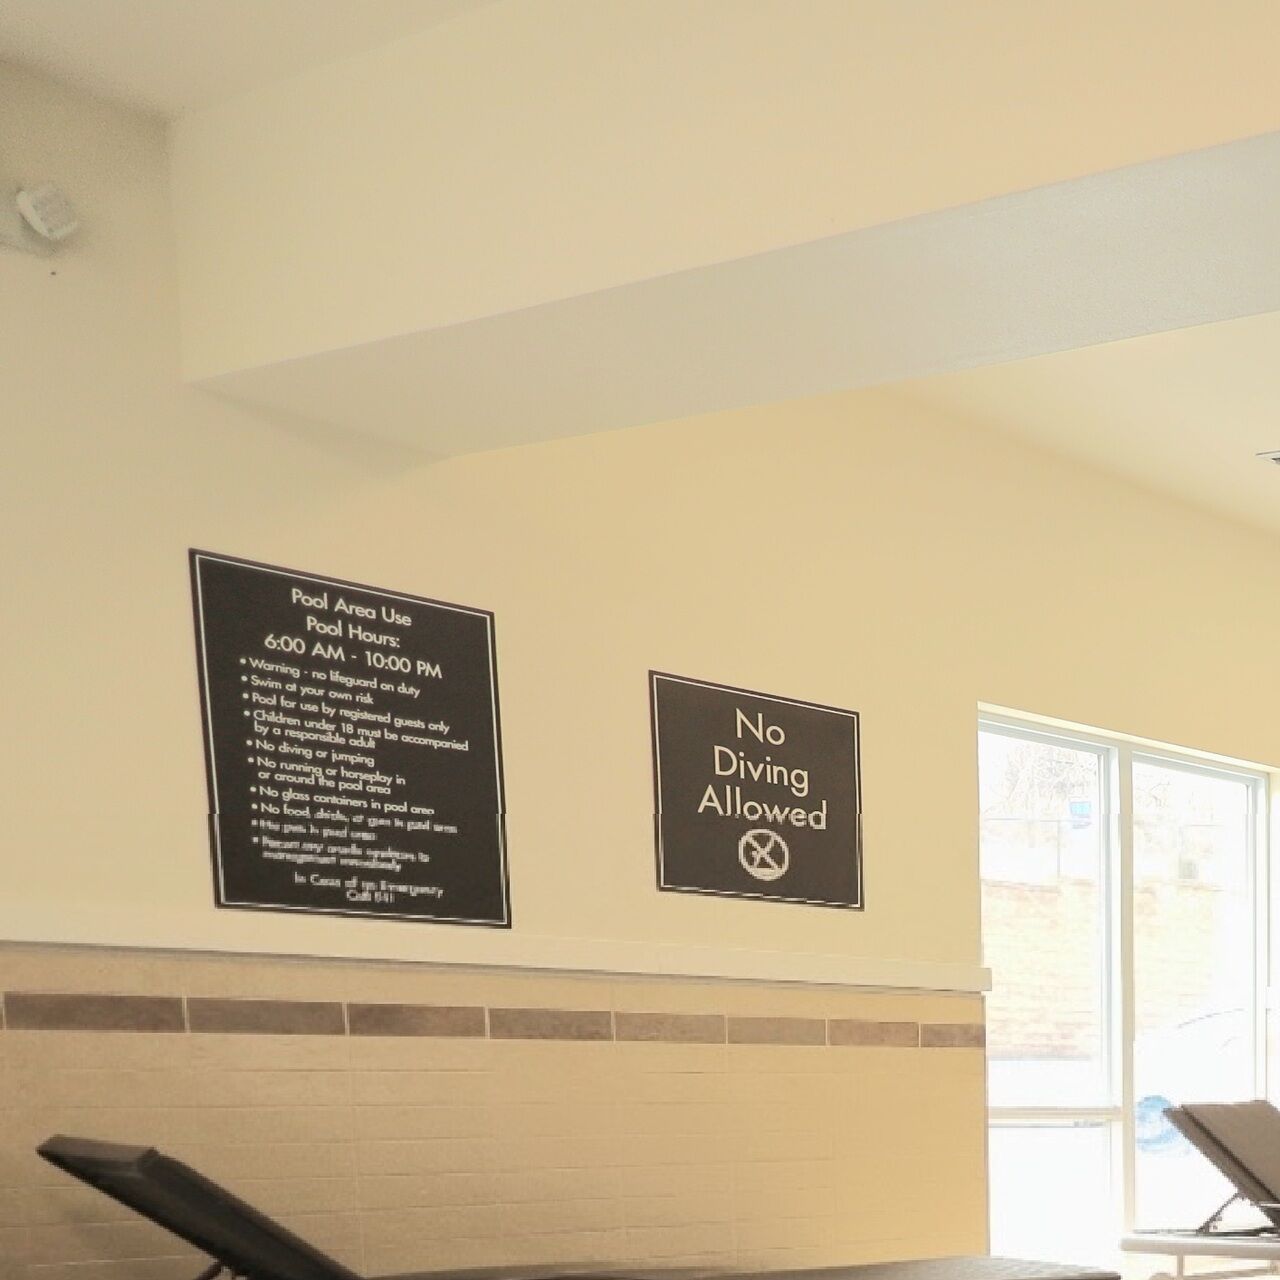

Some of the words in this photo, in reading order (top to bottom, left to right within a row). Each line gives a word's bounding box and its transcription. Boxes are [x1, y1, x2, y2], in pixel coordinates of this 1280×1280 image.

[292, 588, 328, 609] Pool
[334, 598, 376, 619] Area
[382, 606, 412, 626] Use
[306, 616, 342, 637] Pool
[348, 624, 400, 647] Hours:
[264, 634, 306, 654] 6:00
[311, 642, 345, 661] AM
[365, 651, 411, 673] 10:00
[416, 660, 442, 679] PM
[249, 657, 300, 678] Warning
[312, 671, 327, 680] no
[329, 670, 377, 689] lifeguard
[380, 683, 394, 692] on
[397, 682, 420, 698] duty
[251, 675, 282, 689] Swim
[285, 683, 297, 691] at
[300, 686, 325, 696] your
[328, 691, 352, 700] own
[356, 693, 374, 704] risk
[252, 692, 277, 705] Pool
[280, 695, 296, 708] for
[300, 703, 319, 712] use
[321, 702, 336, 717] by
[339, 709, 390, 723] registered
[394, 718, 425, 729] guests
[428, 721, 450, 735] only
[253, 710, 300, 726] Children
[304, 719, 336, 731] under
[341, 722, 354, 734] 18
[357, 728, 381, 738] must
[384, 728, 398, 740] be
[401, 735, 469, 751] accompanied
[736, 708, 785, 745] No
[254, 720, 269, 736] by
[284, 729, 346, 745] responsible
[348, 736, 375, 749] adult
[256, 739, 275, 751] No
[279, 741, 312, 759] diving
[316, 750, 328, 758] or
[331, 749, 375, 767] jumping
[257, 756, 277, 768] No
[280, 762, 322, 776] running
[325, 768, 338, 776] or
[341, 766, 392, 786] horseplay
[396, 774, 406, 785] in
[258, 771, 271, 779] or
[274, 774, 315, 785] around
[319, 775, 335, 787] the
[338, 780, 362, 791] pool
[366, 785, 391, 794] area
[714, 745, 809, 797] Diving
[259, 786, 279, 797] No
[282, 788, 310, 801] glass
[313, 795, 368, 808] containers
[371, 799, 381, 809] in
[384, 801, 407, 813] pool
[410, 806, 435, 814] area
[261, 802, 280, 814] No
[698, 784, 826, 829] Allowed
